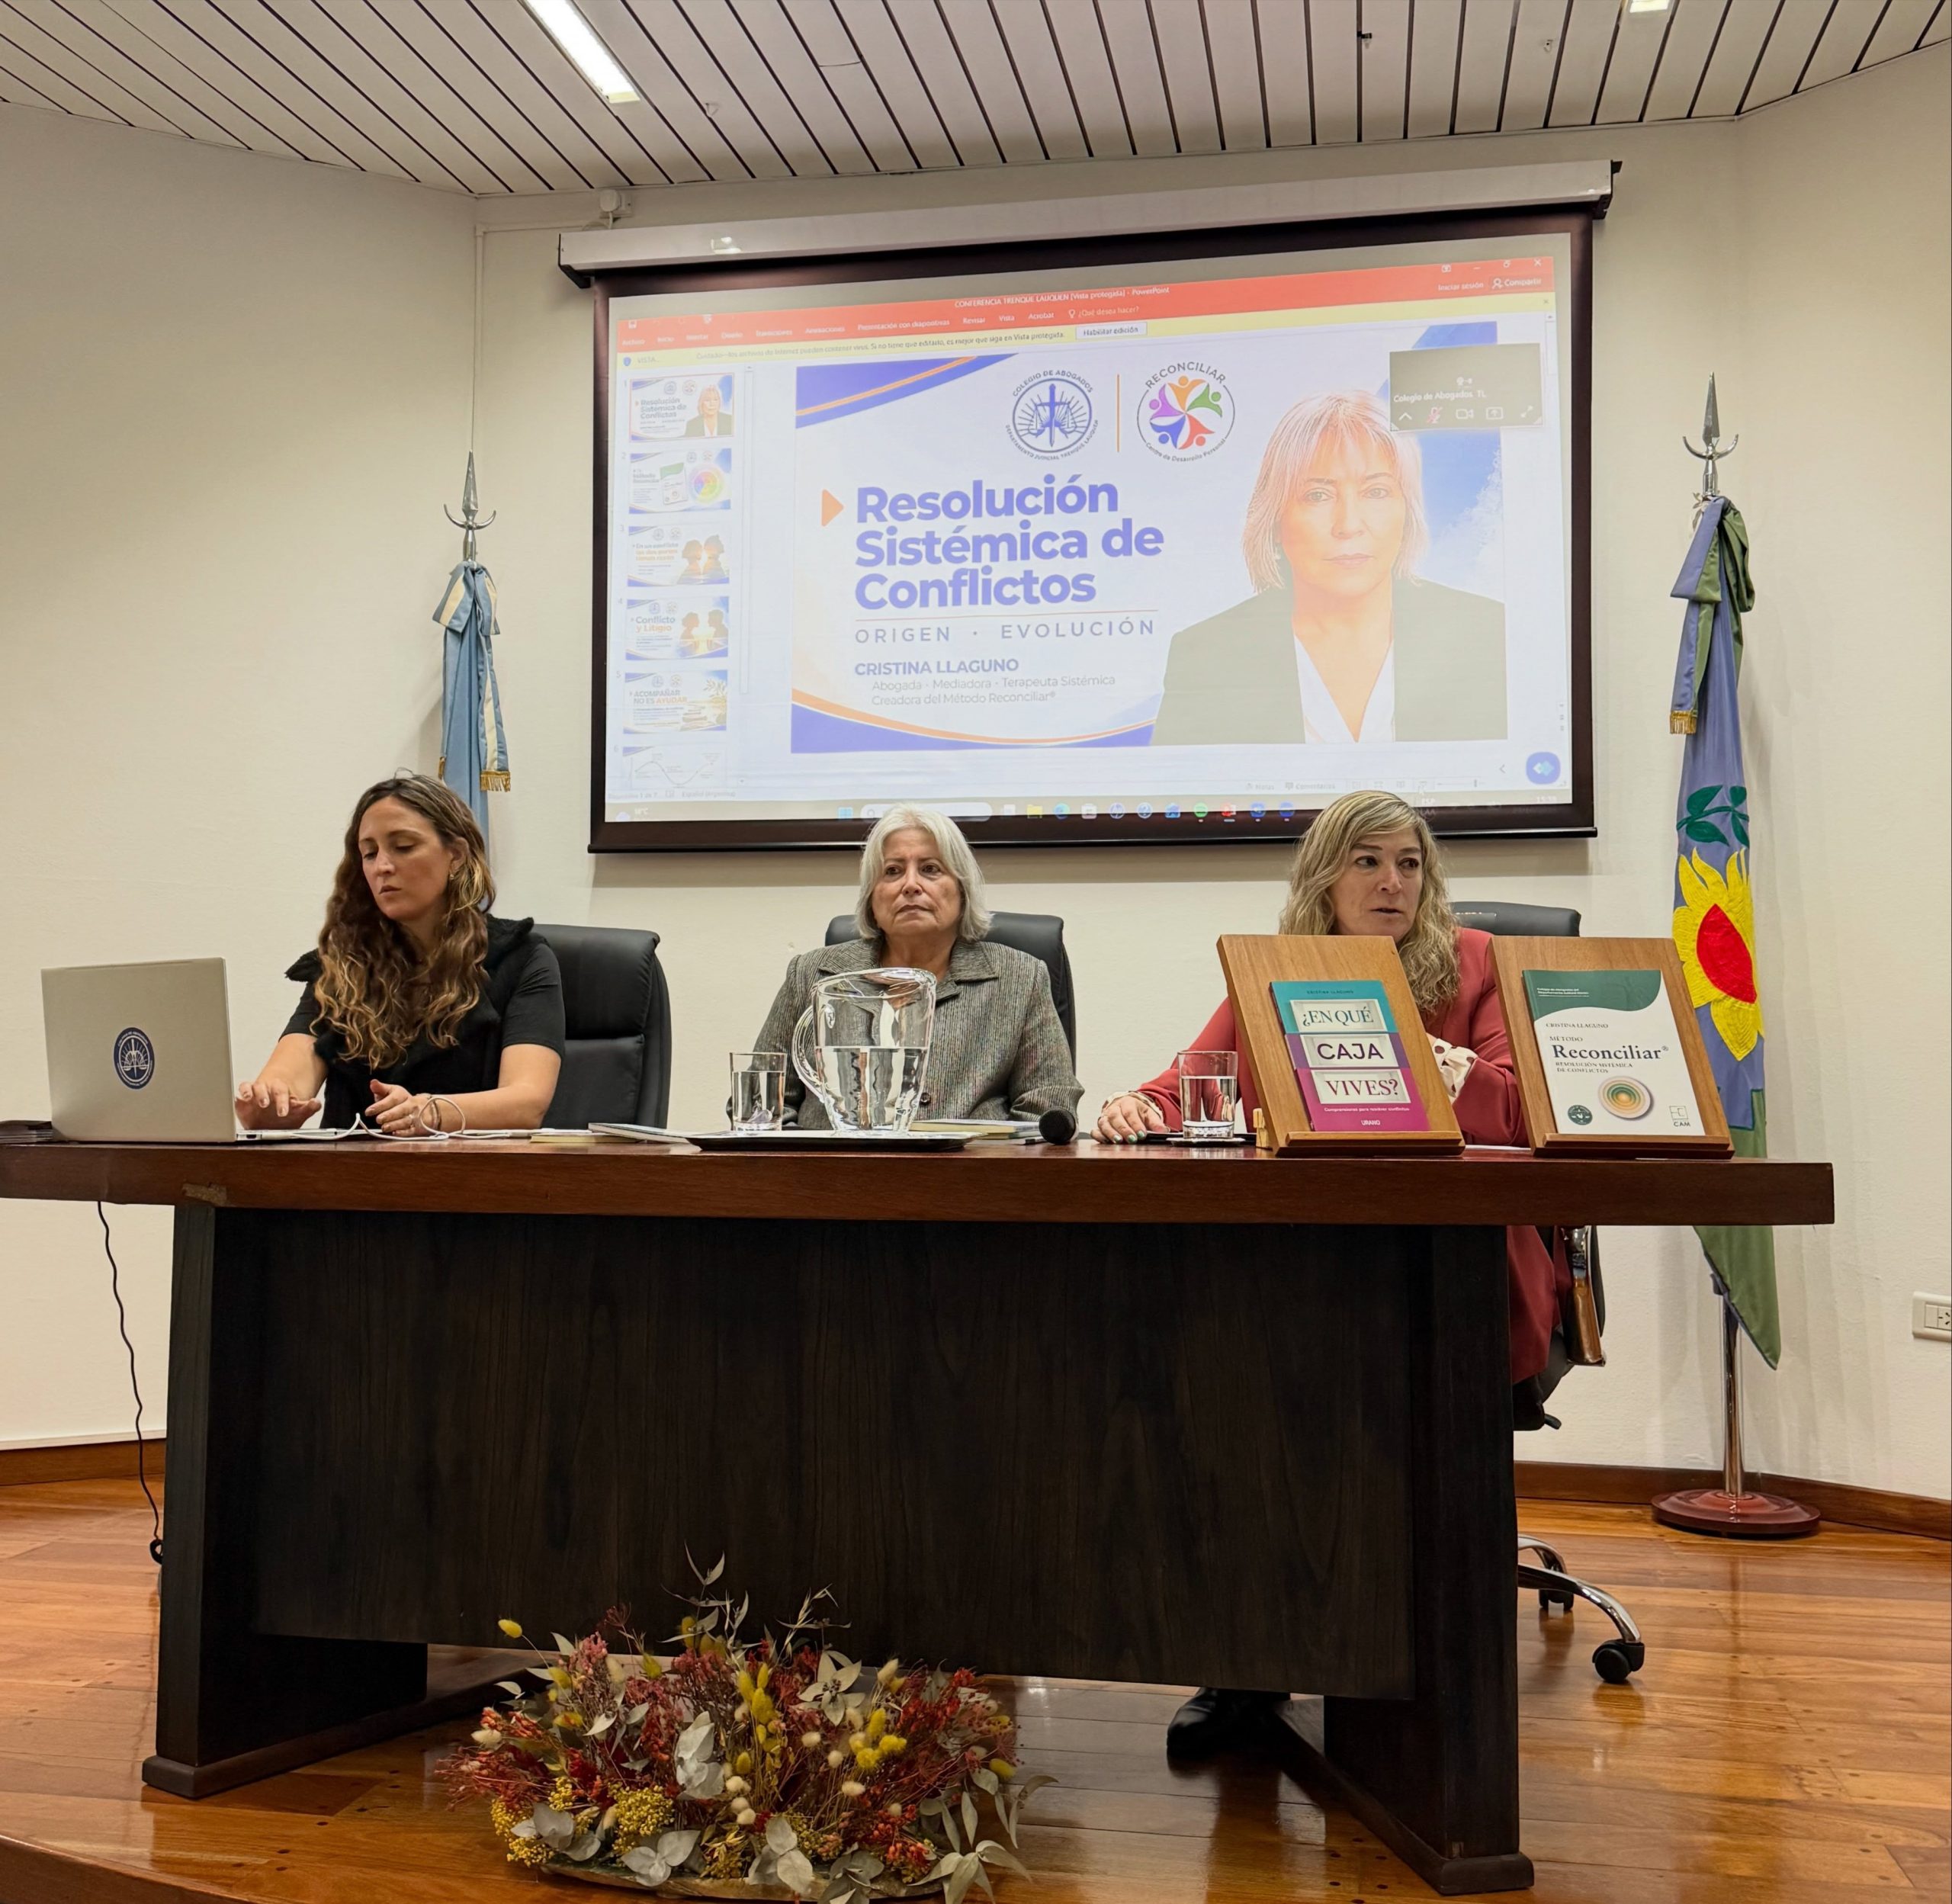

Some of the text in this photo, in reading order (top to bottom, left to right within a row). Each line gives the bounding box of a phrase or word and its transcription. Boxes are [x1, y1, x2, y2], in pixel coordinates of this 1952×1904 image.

[1461, 281, 1483, 290] sesión
[1504, 278, 1542, 287] Compartir
[955, 297, 1002, 308] CONFERENCIA
[1003, 296, 1034, 306] TRENQUE
[1035, 293, 1069, 303] LAUQUEN
[1132, 287, 1170, 296] PowerPoint
[1077, 305, 1139, 318] ¿Qué desea hacer?
[857, 321, 897, 331] Presentación
[912, 318, 949, 329] diapositivas
[962, 316, 986, 325] Revisar
[1028, 312, 1055, 320] Acrobat
[1084, 325, 1138, 337] Habilitar edición
[800, 345, 823, 355] pueden
[824, 345, 852, 354] contener
[888, 340, 904, 348] tiene
[905, 341, 917, 350] que
[955, 336, 974, 347] mejor
[975, 337, 987, 346] que
[989, 335, 1003, 345] siga
[1013, 333, 1029, 342] Vista
[1031, 331, 1064, 342] protegida.
[1013, 372, 1042, 397] COLEGIO
[1055, 370, 1093, 393] ABOGADOS
[1145, 361, 1226, 389] RECONCILIAR
[640, 397, 681, 406] Resolución
[1393, 393, 1421, 403] Colegio
[1423, 392, 1433, 400] de
[640, 403, 687, 413] Sistémica de
[857, 474, 1119, 524] Resolución
[856, 518, 1164, 568] Sistémica de
[856, 565, 1096, 611] Conflictos
[635, 615, 676, 624] Conflicto
[635, 623, 673, 634] y Litigio
[855, 626, 952, 644] ORIGEN
[1001, 616, 1155, 640] EVOLUCIÓN
[854, 657, 1019, 676] CRISTINA LLAGUNO
[634, 689, 681, 697] ACOMPAÑAR
[872, 679, 923, 693] Abogada
[933, 677, 992, 690] Mediadora
[1001, 676, 1058, 691] Terapeuta
[1061, 675, 1116, 688] Sistémica
[872, 693, 922, 706] Creadora
[924, 692, 941, 705] del
[943, 691, 986, 704] Método
[1303, 1006, 1375, 1026] ¿EN QUÉ
[1317, 1043, 1384, 1060] CAJA
[1326, 1078, 1398, 1096] VIVES?
